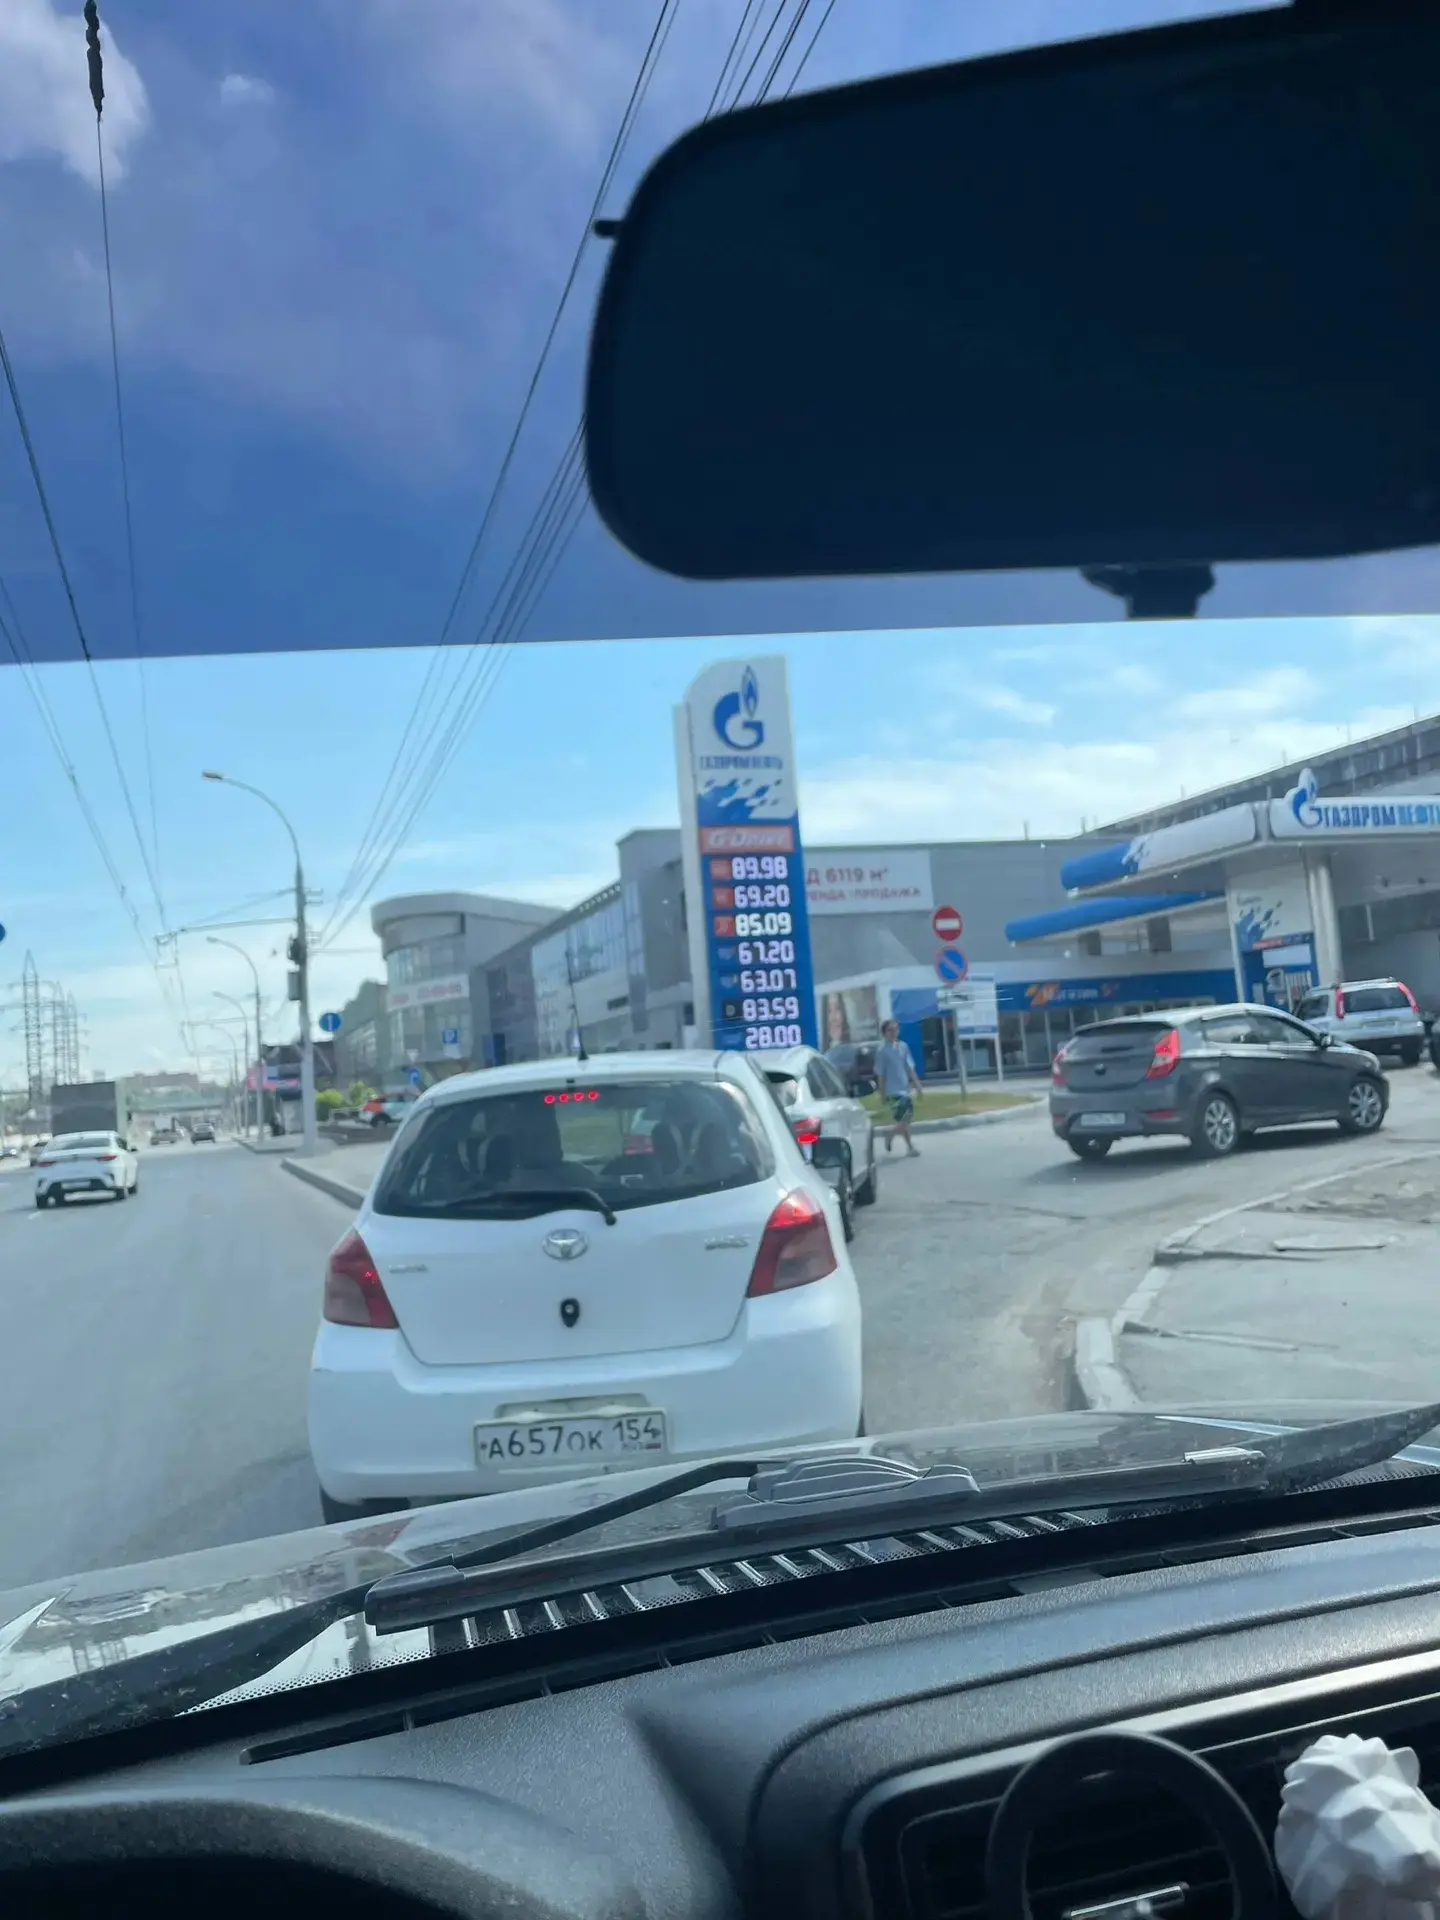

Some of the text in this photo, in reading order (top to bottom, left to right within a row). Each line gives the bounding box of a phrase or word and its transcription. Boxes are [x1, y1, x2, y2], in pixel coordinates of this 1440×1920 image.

[732, 856, 788, 880] 89.98
[825, 867, 863, 882] 6119
[734, 884, 790, 908] 69.20
[735, 912, 792, 937] 85.09
[738, 940, 795, 965] 67.20
[740, 968, 797, 993] 63.07
[743, 996, 799, 1021] 83.59
[745, 1024, 801, 1049] 28.00
[613, 1417, 662, 1442] 154
